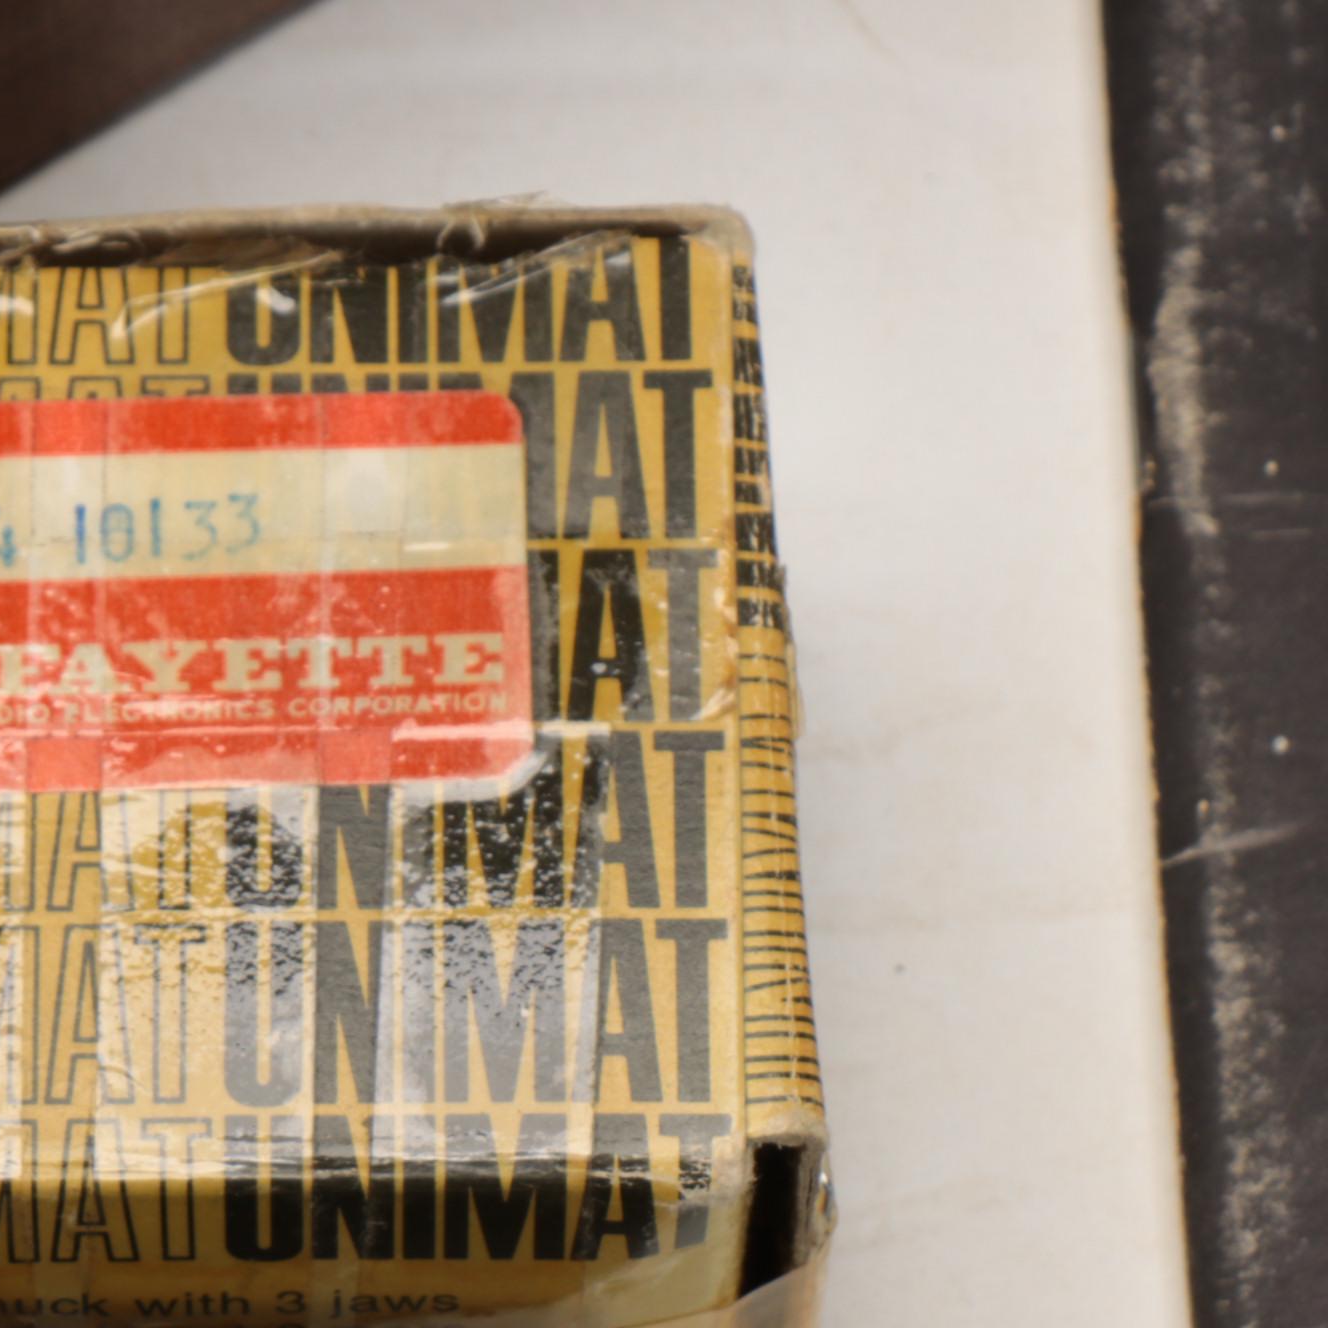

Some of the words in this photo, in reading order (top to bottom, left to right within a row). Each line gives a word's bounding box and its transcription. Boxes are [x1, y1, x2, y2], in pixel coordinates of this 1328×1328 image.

[287, 690, 507, 719] CORPORATION
[224, 918, 728, 1108] UNIMAT
[224, 1112, 734, 1262] UNIMAT
[135, 1289, 251, 1318] with
[276, 1290, 307, 1315] 3
[329, 1289, 461, 1319] jaws
